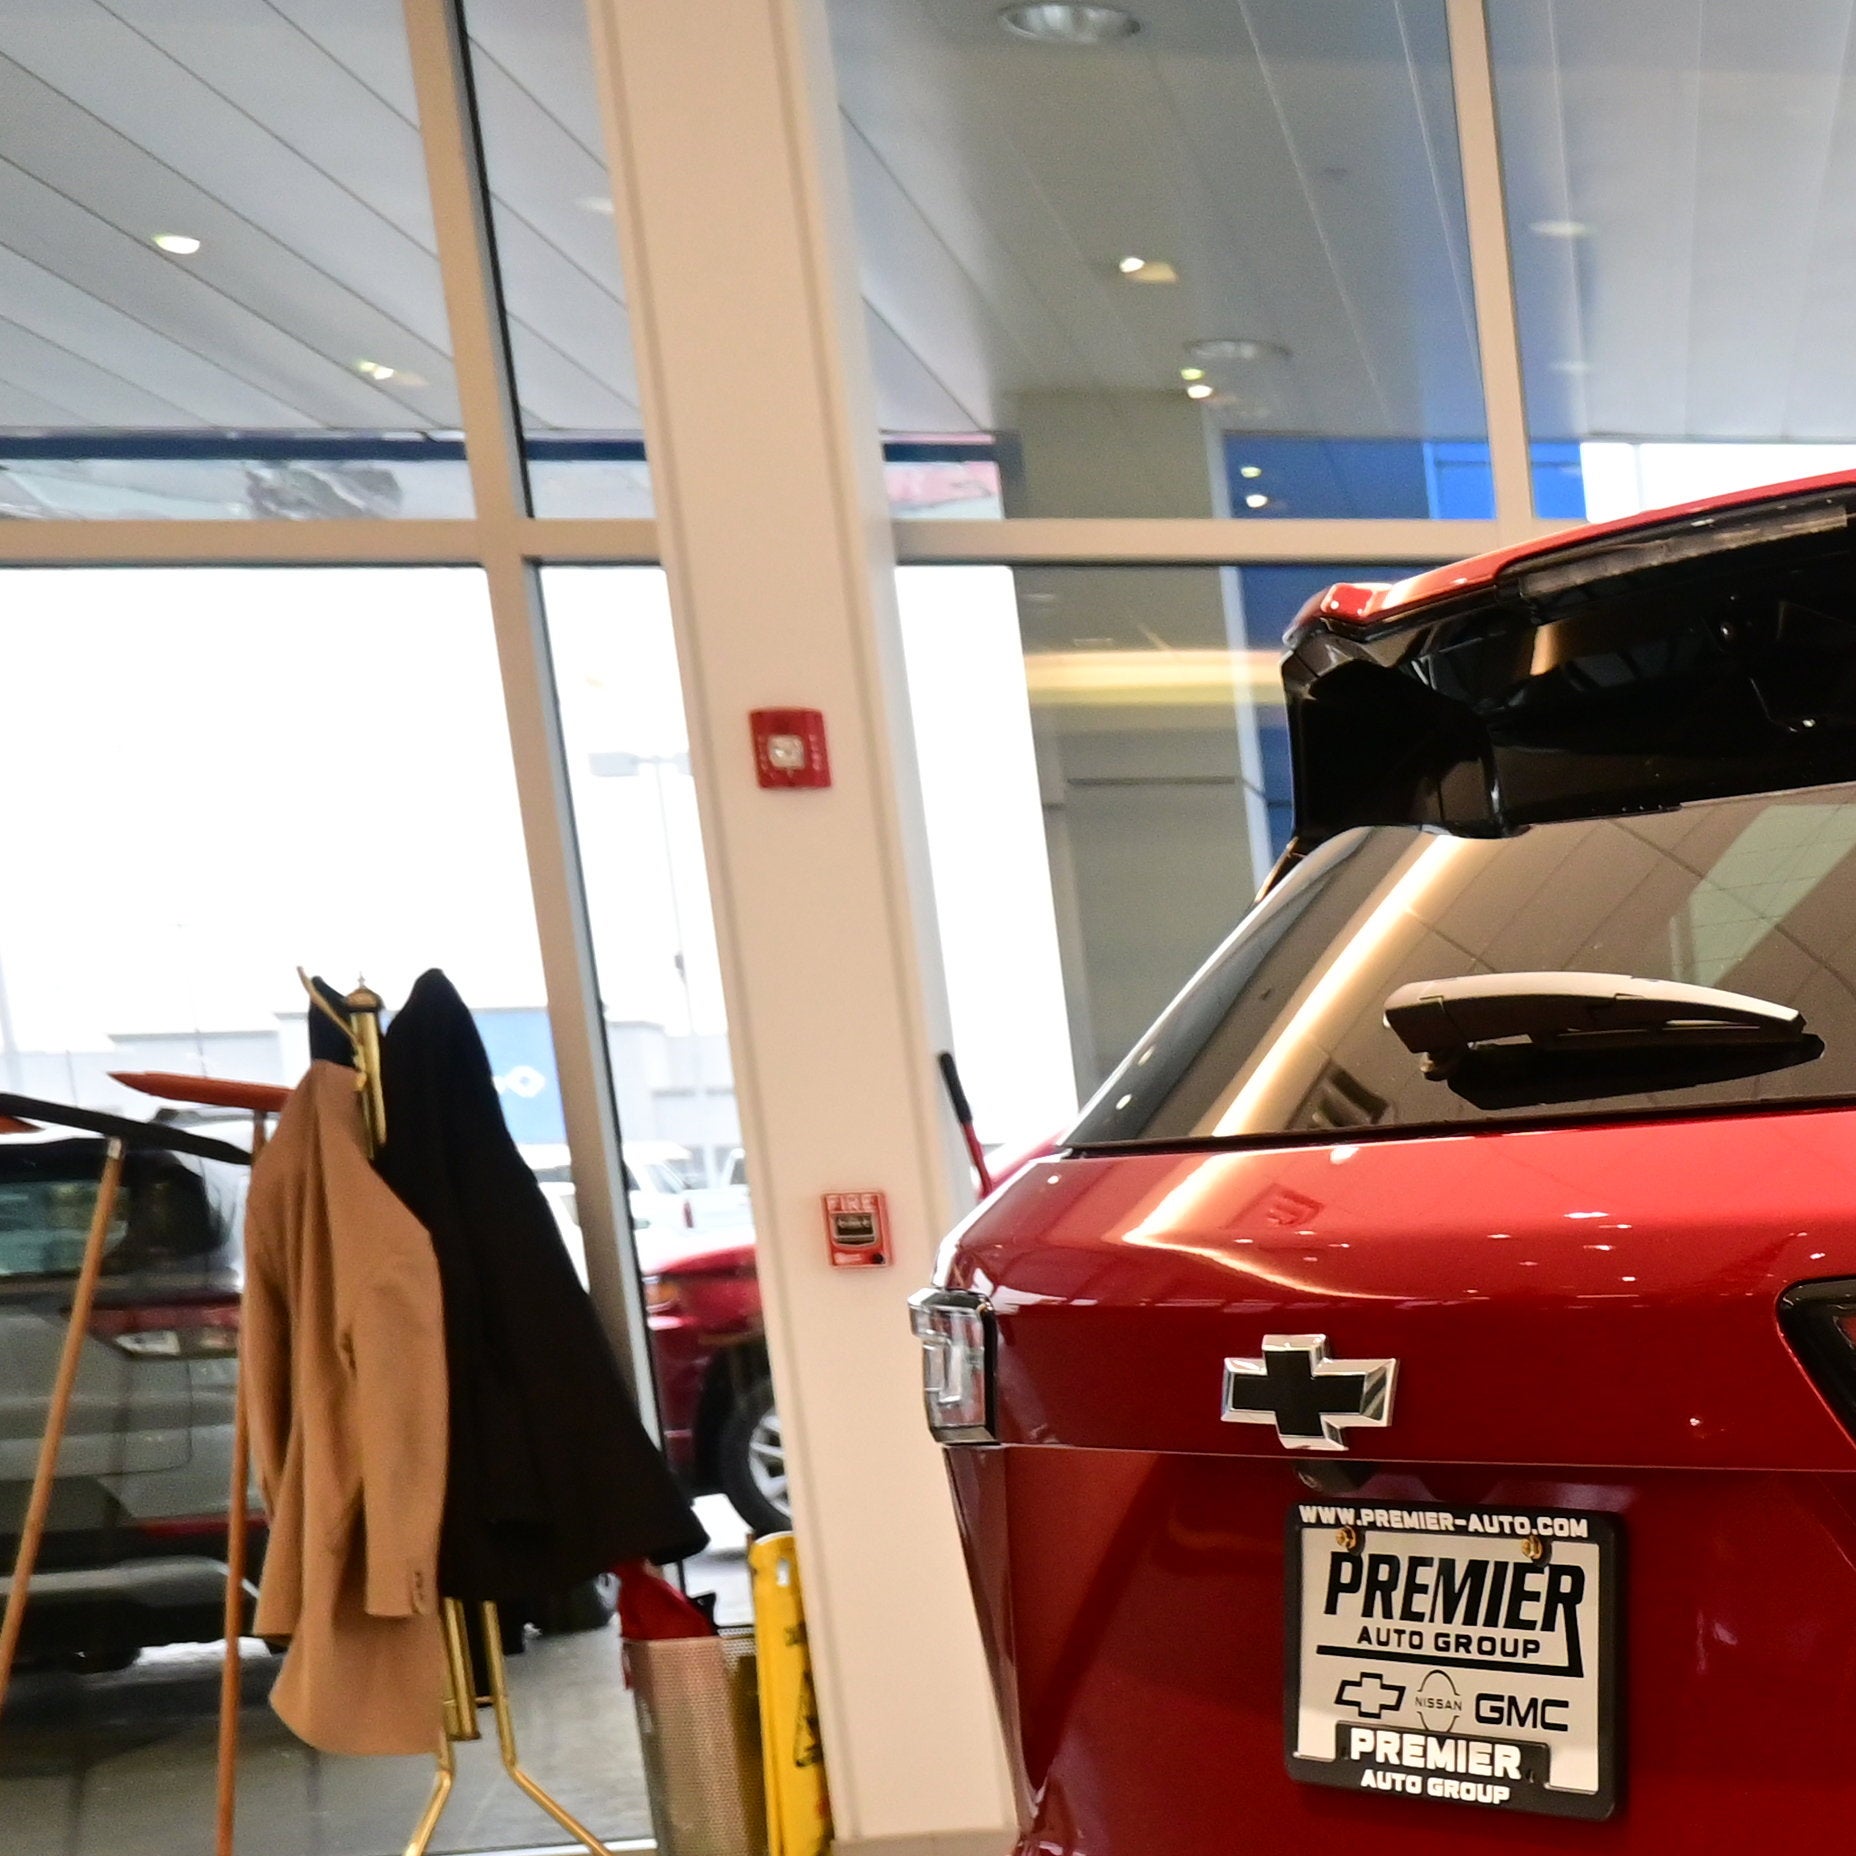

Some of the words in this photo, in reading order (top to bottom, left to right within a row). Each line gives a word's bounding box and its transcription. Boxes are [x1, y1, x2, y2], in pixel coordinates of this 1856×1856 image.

[1299, 1505, 1589, 1538] WWW.PREMIER-AUTO.COM
[1324, 1551, 1585, 1634] PREMIER
[1357, 1625, 1424, 1650] AUTO
[1434, 1632, 1541, 1659] GROUP
[1415, 1696, 1463, 1712] NISSAN
[1475, 1692, 1570, 1732] GMC
[1350, 1728, 1522, 1780] PREMIER
[1360, 1768, 1423, 1795] AUTO
[1427, 1775, 1511, 1805] GROUP
